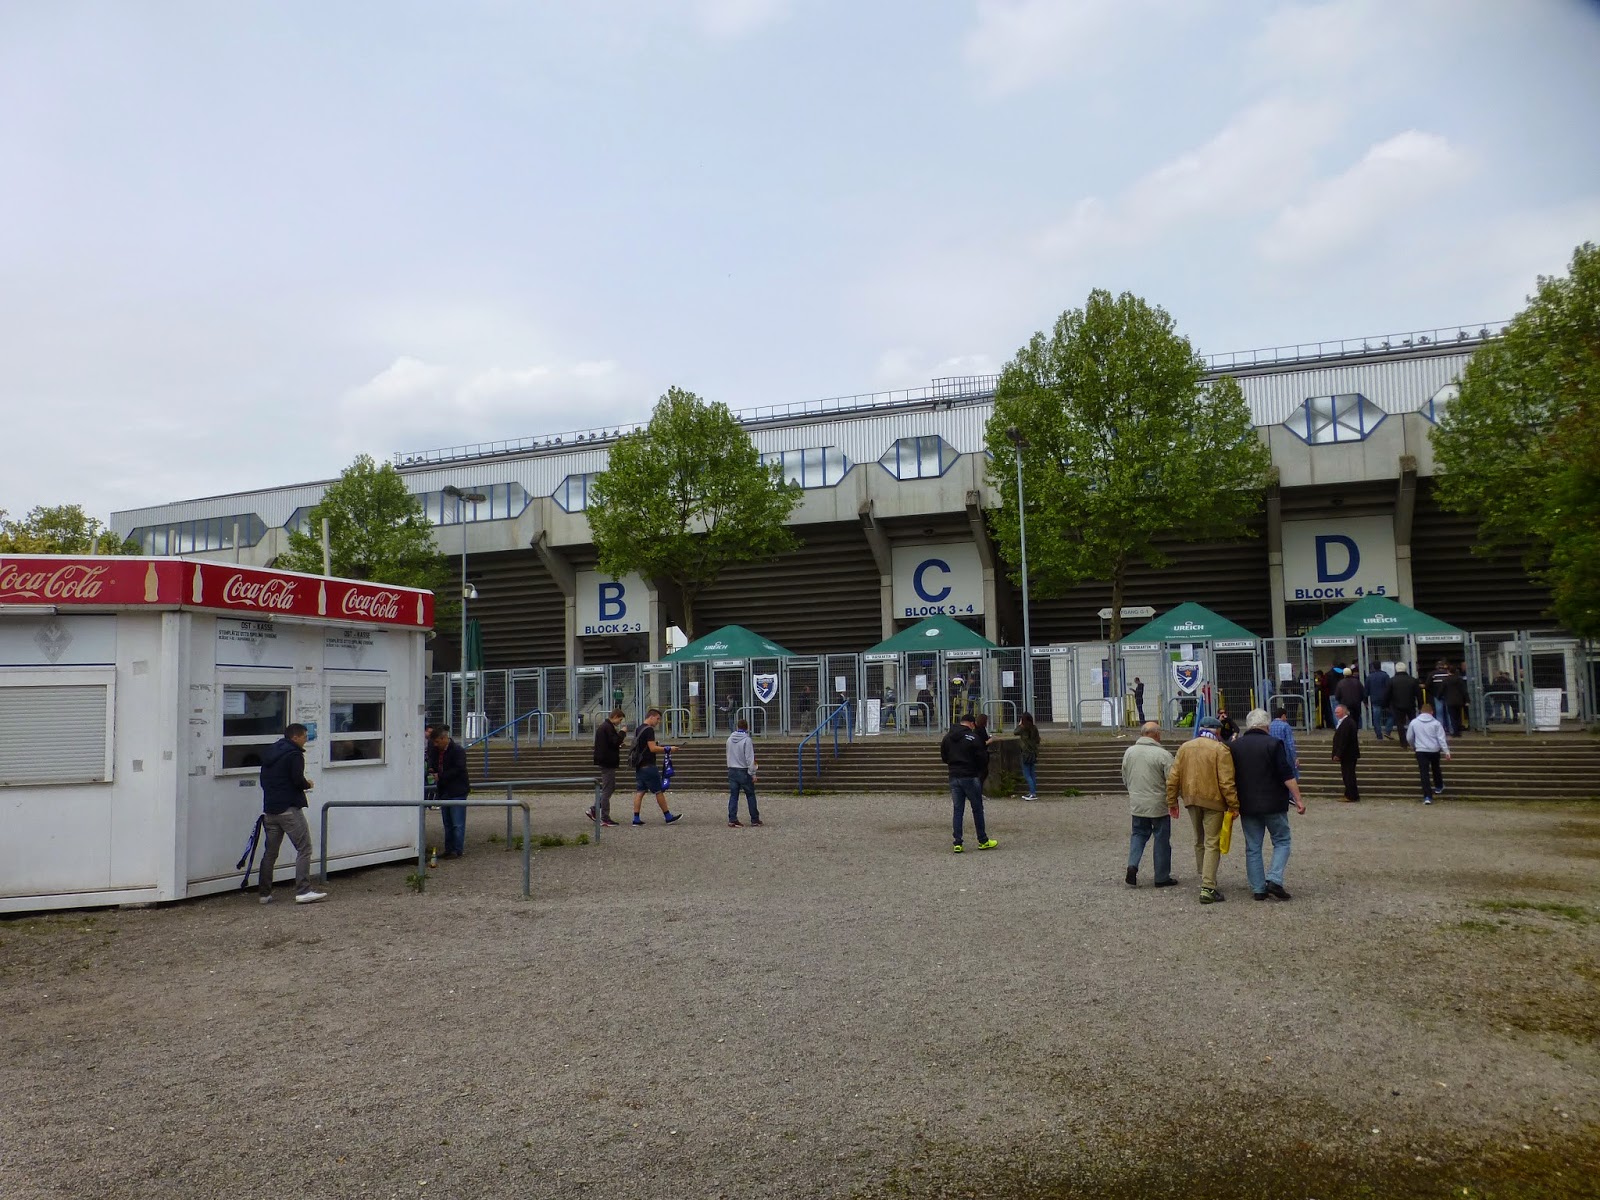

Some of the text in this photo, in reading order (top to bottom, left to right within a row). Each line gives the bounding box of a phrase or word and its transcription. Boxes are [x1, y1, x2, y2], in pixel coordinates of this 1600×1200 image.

[1315, 535, 1360, 583] D
[223, 574, 299, 610] Coca-Cola
[913, 558, 951, 602] C
[1295, 588, 1345, 599] BLOCK
[342, 588, 401, 619] Coca-Cola
[599, 582, 627, 621] B
[905, 606, 946, 617] BLOCK
[585, 624, 620, 634] BLOCK
